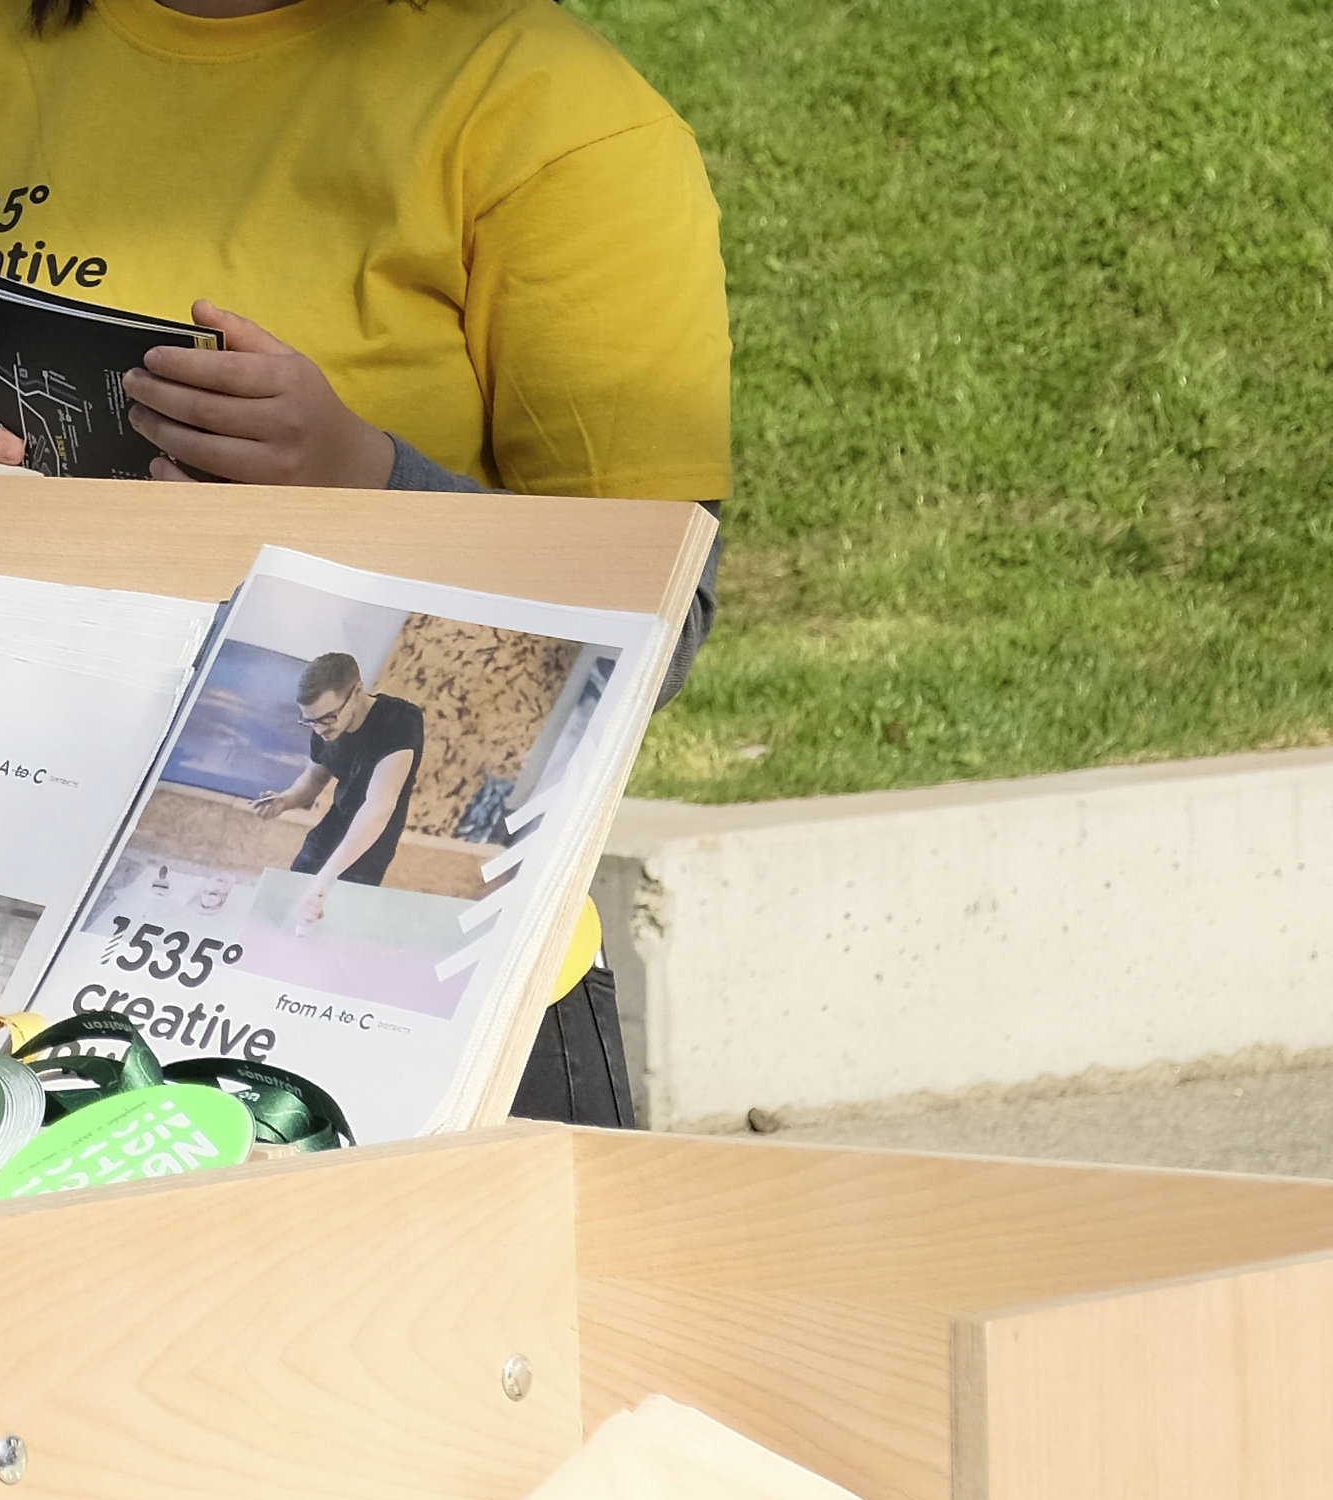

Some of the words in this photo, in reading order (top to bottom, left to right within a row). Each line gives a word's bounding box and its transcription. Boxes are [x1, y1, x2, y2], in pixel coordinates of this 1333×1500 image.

[33, 768, 47, 784] C
[101, 915, 244, 988] 1535°
[72, 983, 277, 1064] creative
[275, 993, 318, 1020] from
[318, 1004, 333, 1023] A
[358, 1013, 374, 1031] C
